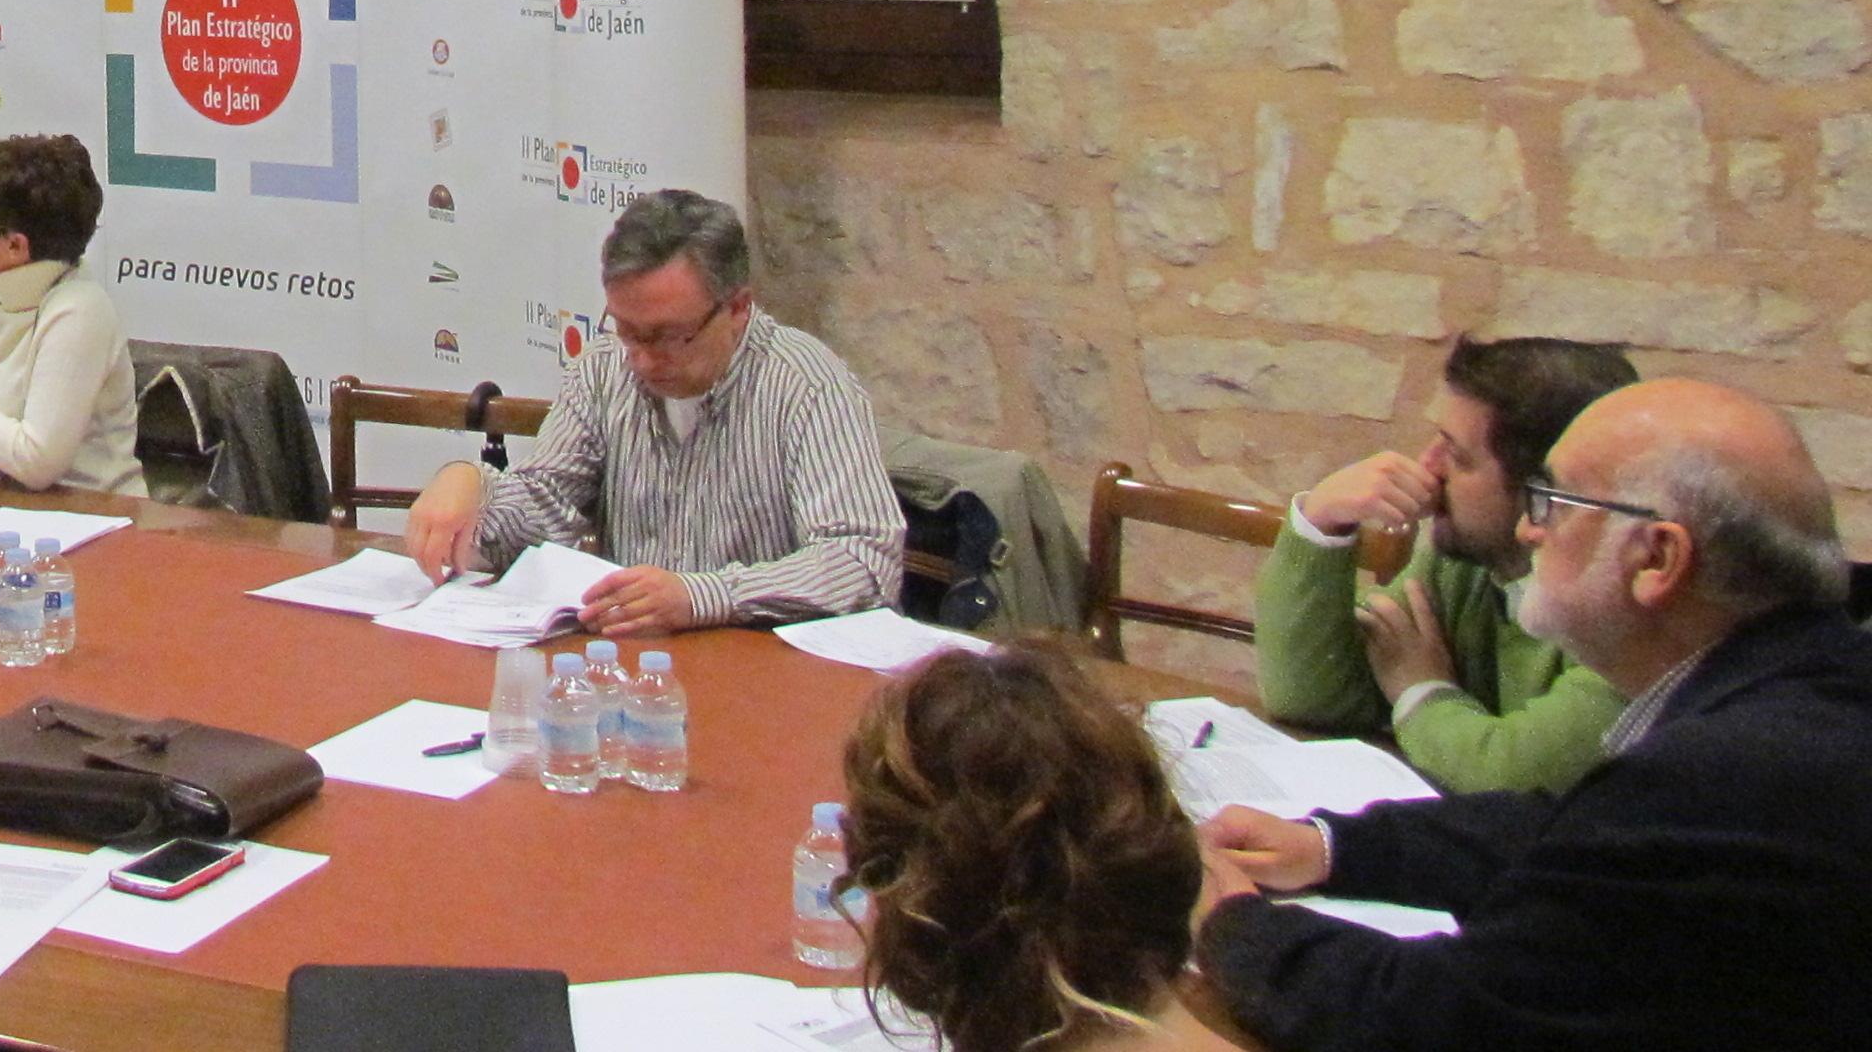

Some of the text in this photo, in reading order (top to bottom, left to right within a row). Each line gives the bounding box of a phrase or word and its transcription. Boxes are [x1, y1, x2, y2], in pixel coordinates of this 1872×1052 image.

[167, 10, 293, 48] Plan Estratégico
[588, 8, 644, 40] de Jaén
[182, 49, 278, 80] de la provincia
[203, 84, 260, 116] de Jaén
[521, 136, 555, 163] II Plan
[590, 154, 647, 179] Estratégico
[590, 181, 605, 205] de
[117, 257, 355, 300] para nuevos retos
[526, 300, 558, 329] II Plan
